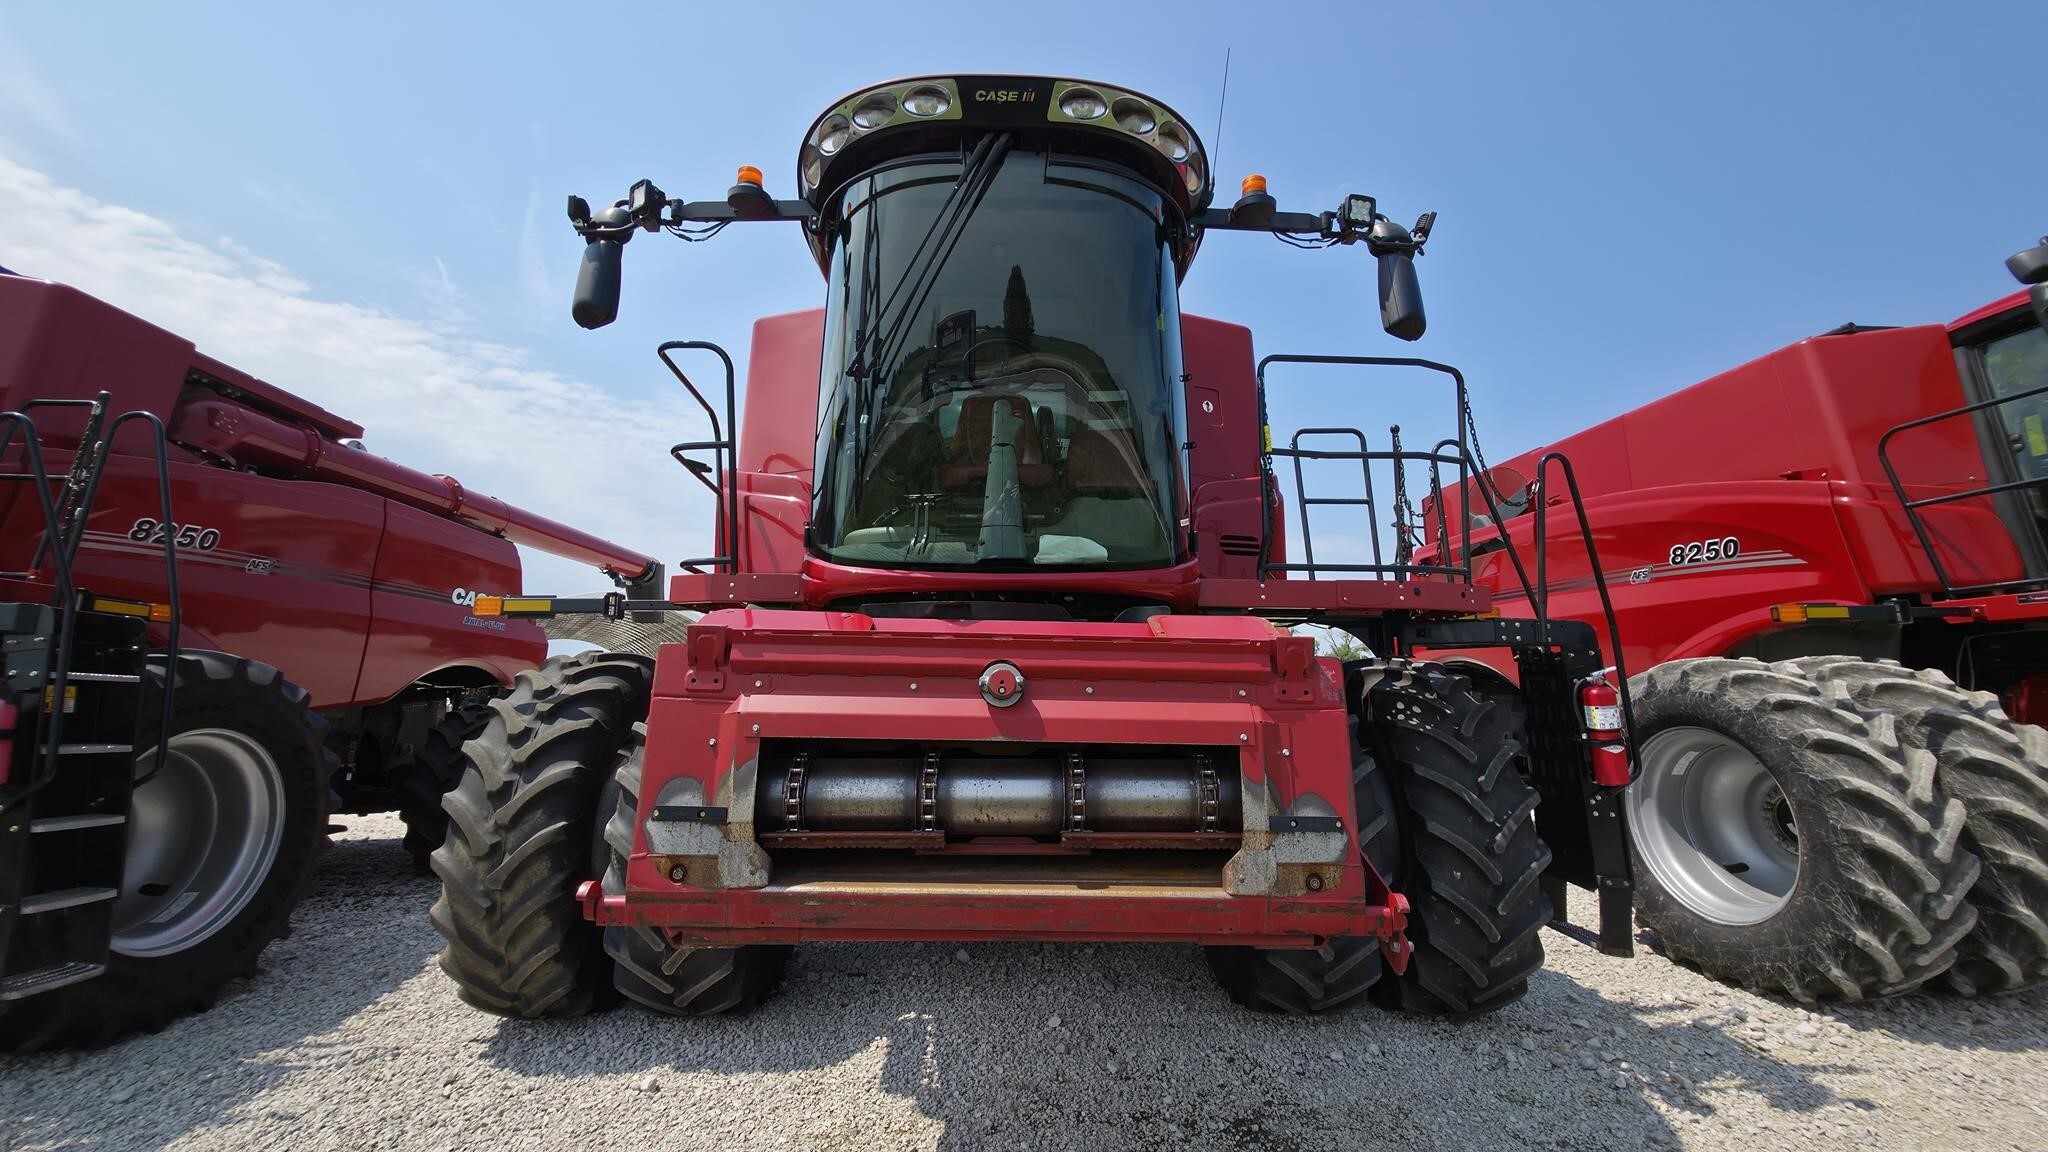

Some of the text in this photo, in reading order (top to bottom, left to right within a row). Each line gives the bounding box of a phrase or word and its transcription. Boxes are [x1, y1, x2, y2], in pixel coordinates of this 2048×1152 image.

[975, 89, 1019, 102] CASE
[128, 518, 221, 552] 8250
[1669, 536, 1741, 566] 8250
[247, 559, 271, 571] AFS
[1630, 569, 1649, 580] AFS
